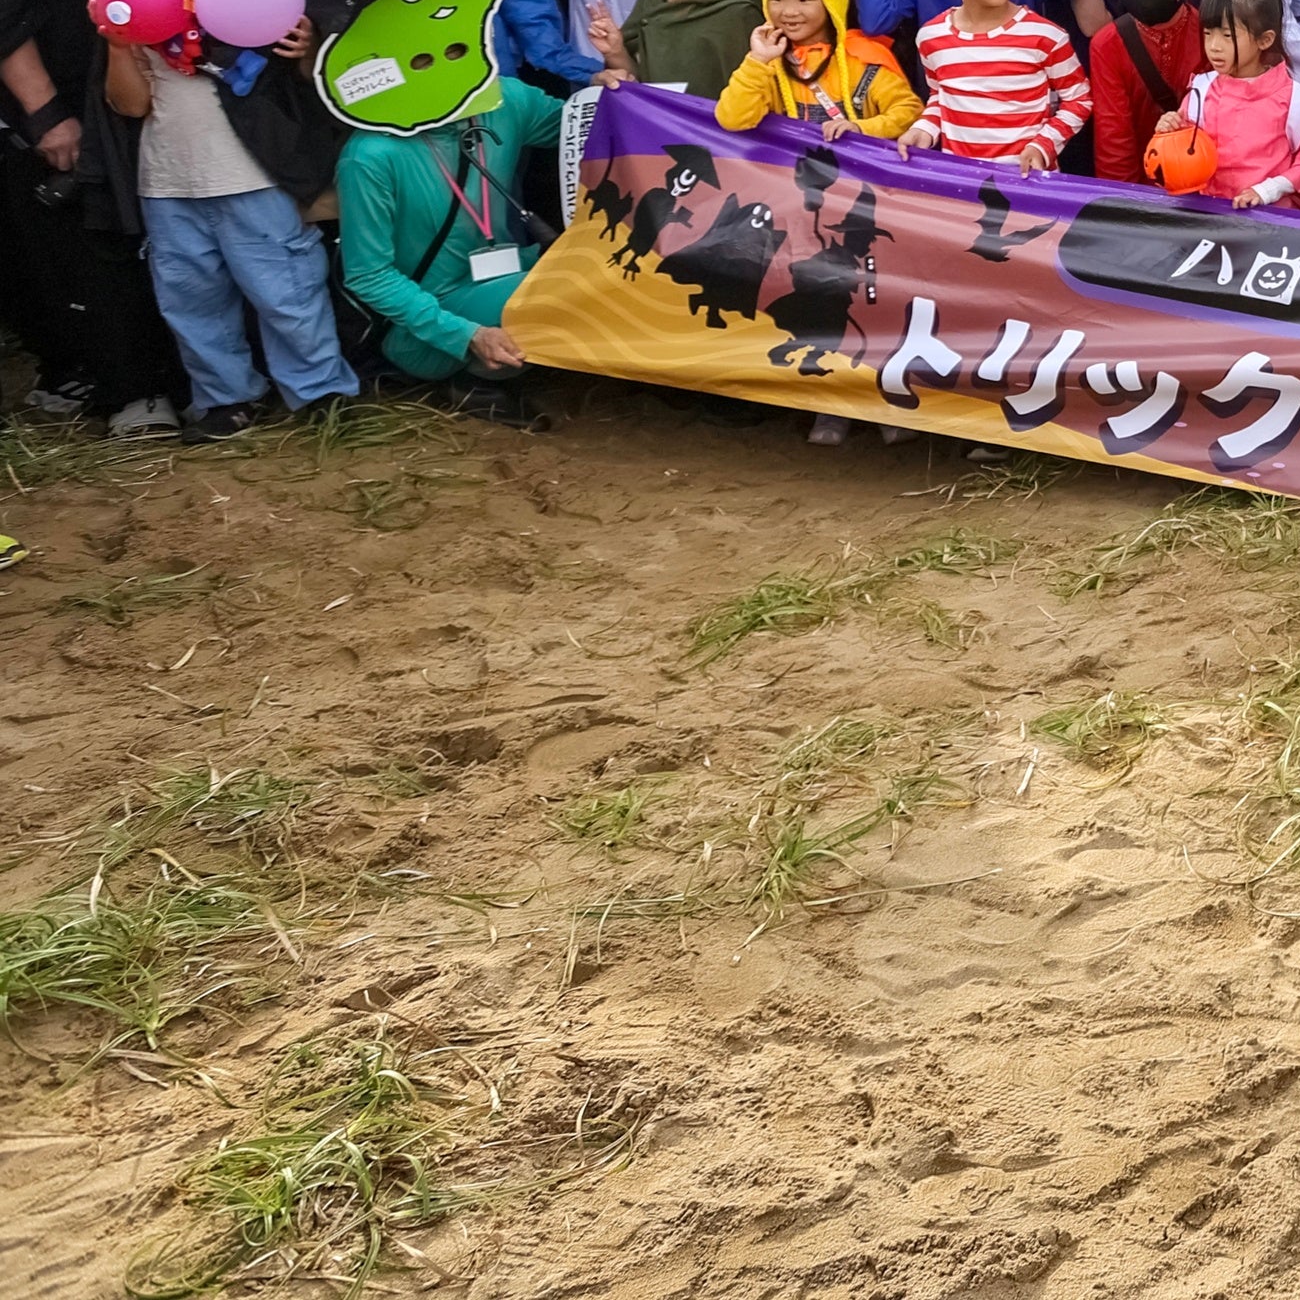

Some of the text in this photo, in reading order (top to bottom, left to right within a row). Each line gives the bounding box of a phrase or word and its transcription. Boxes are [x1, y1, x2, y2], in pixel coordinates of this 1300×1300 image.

[346, 76, 396, 99] ナウルくん
